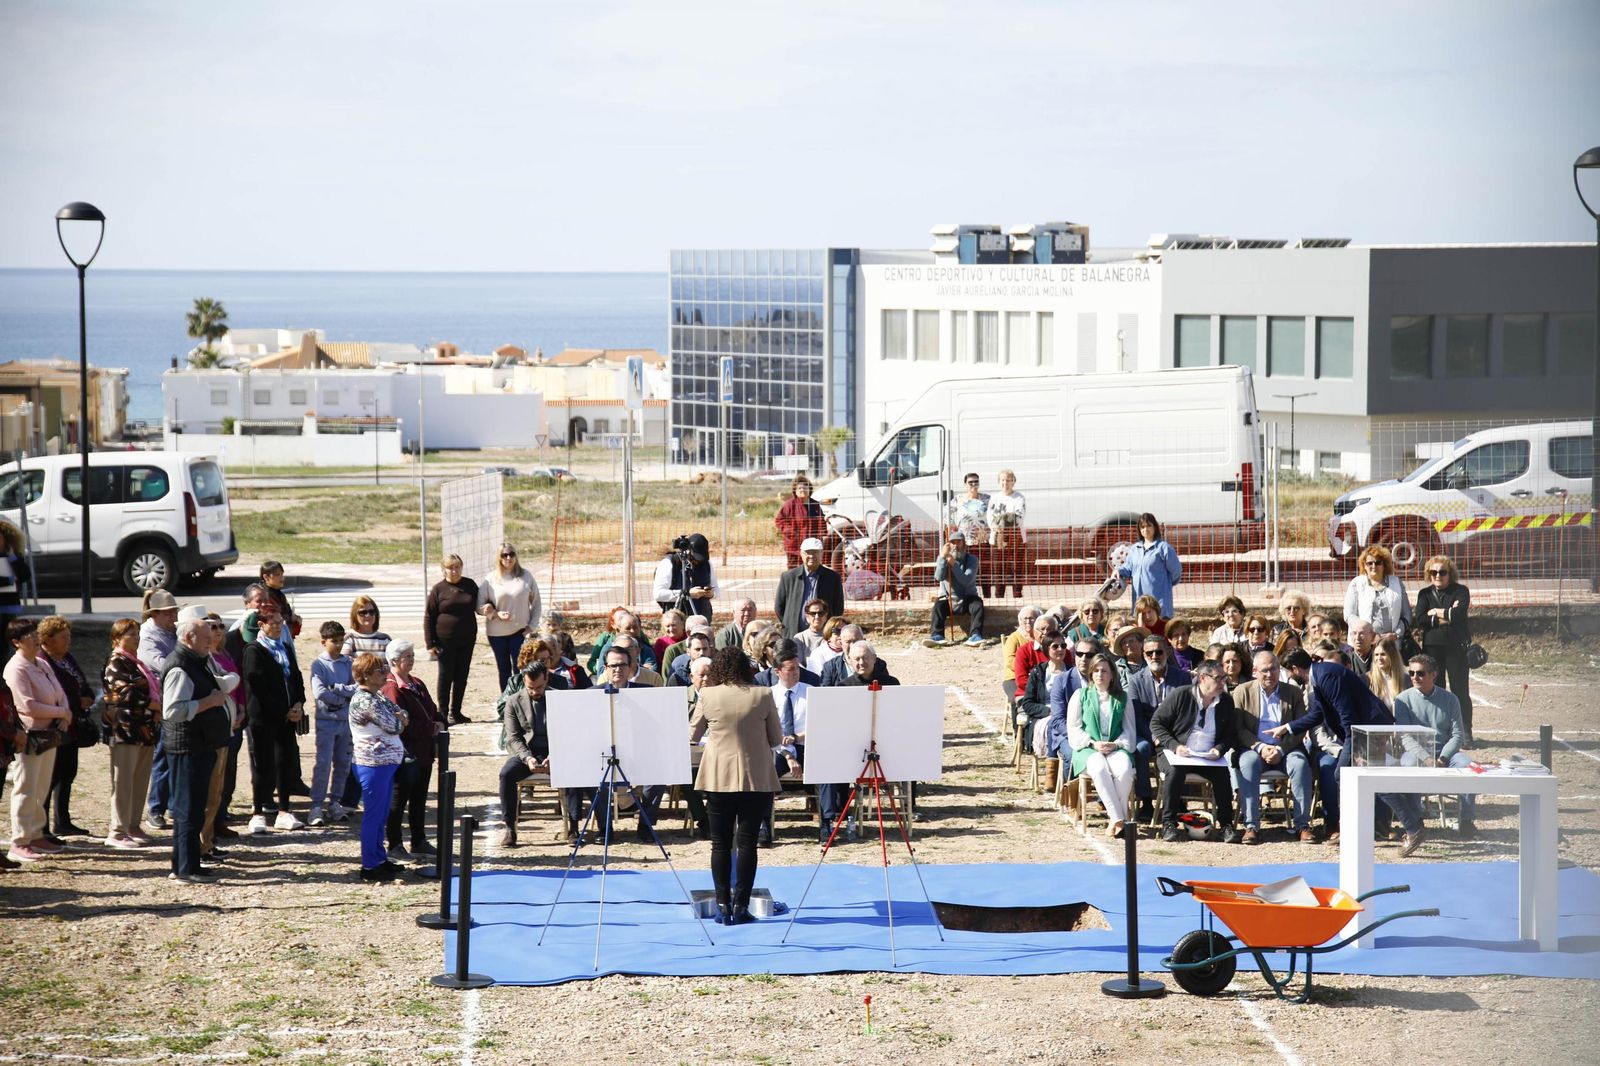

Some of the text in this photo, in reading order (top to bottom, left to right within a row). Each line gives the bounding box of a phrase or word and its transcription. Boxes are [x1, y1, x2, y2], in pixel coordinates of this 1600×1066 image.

[885, 267, 1151, 282] CENTRO DEPORTIVO Y CULTURAL DE BALANEGRA
[936, 285, 962, 296] JAVIER
[964, 285, 1008, 296] AURELIANO
[1042, 285, 1074, 297] MOLINA
